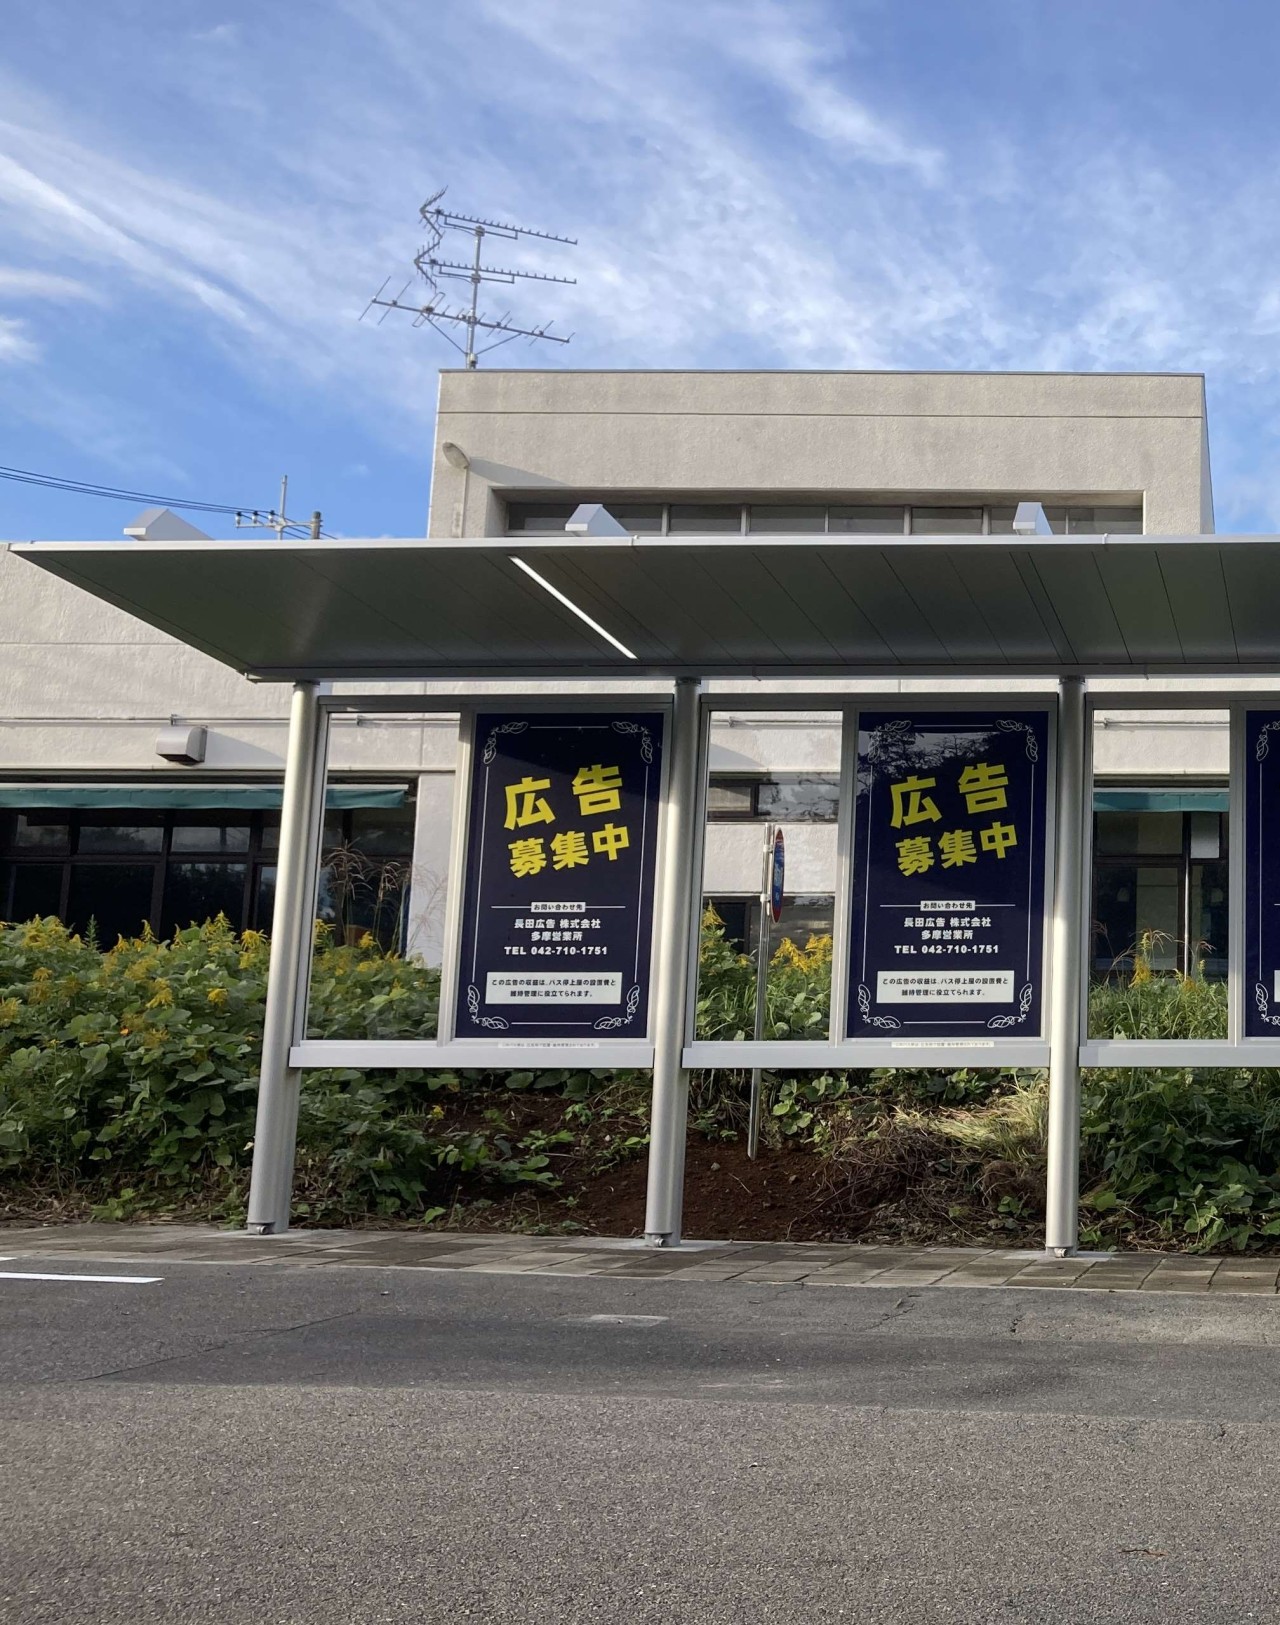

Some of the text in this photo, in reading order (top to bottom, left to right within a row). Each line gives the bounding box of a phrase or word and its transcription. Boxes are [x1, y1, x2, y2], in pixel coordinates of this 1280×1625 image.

[505, 765, 623, 830] 広告
[892, 763, 1009, 828] 広告
[508, 824, 630, 878] 募集中
[898, 822, 1017, 876] 募集中
[534, 903, 583, 911] お問い合わせ先
[514, 919, 601, 929] 長田広告 株式会社
[904, 917, 992, 927] 長田広告 株式会社
[531, 931, 583, 941] 多摩営業所
[921, 930, 973, 940] 多摩営業所
[504, 946, 608, 955] TEL 042-710-1751
[894, 945, 999, 954] TEL 042-710-1751
